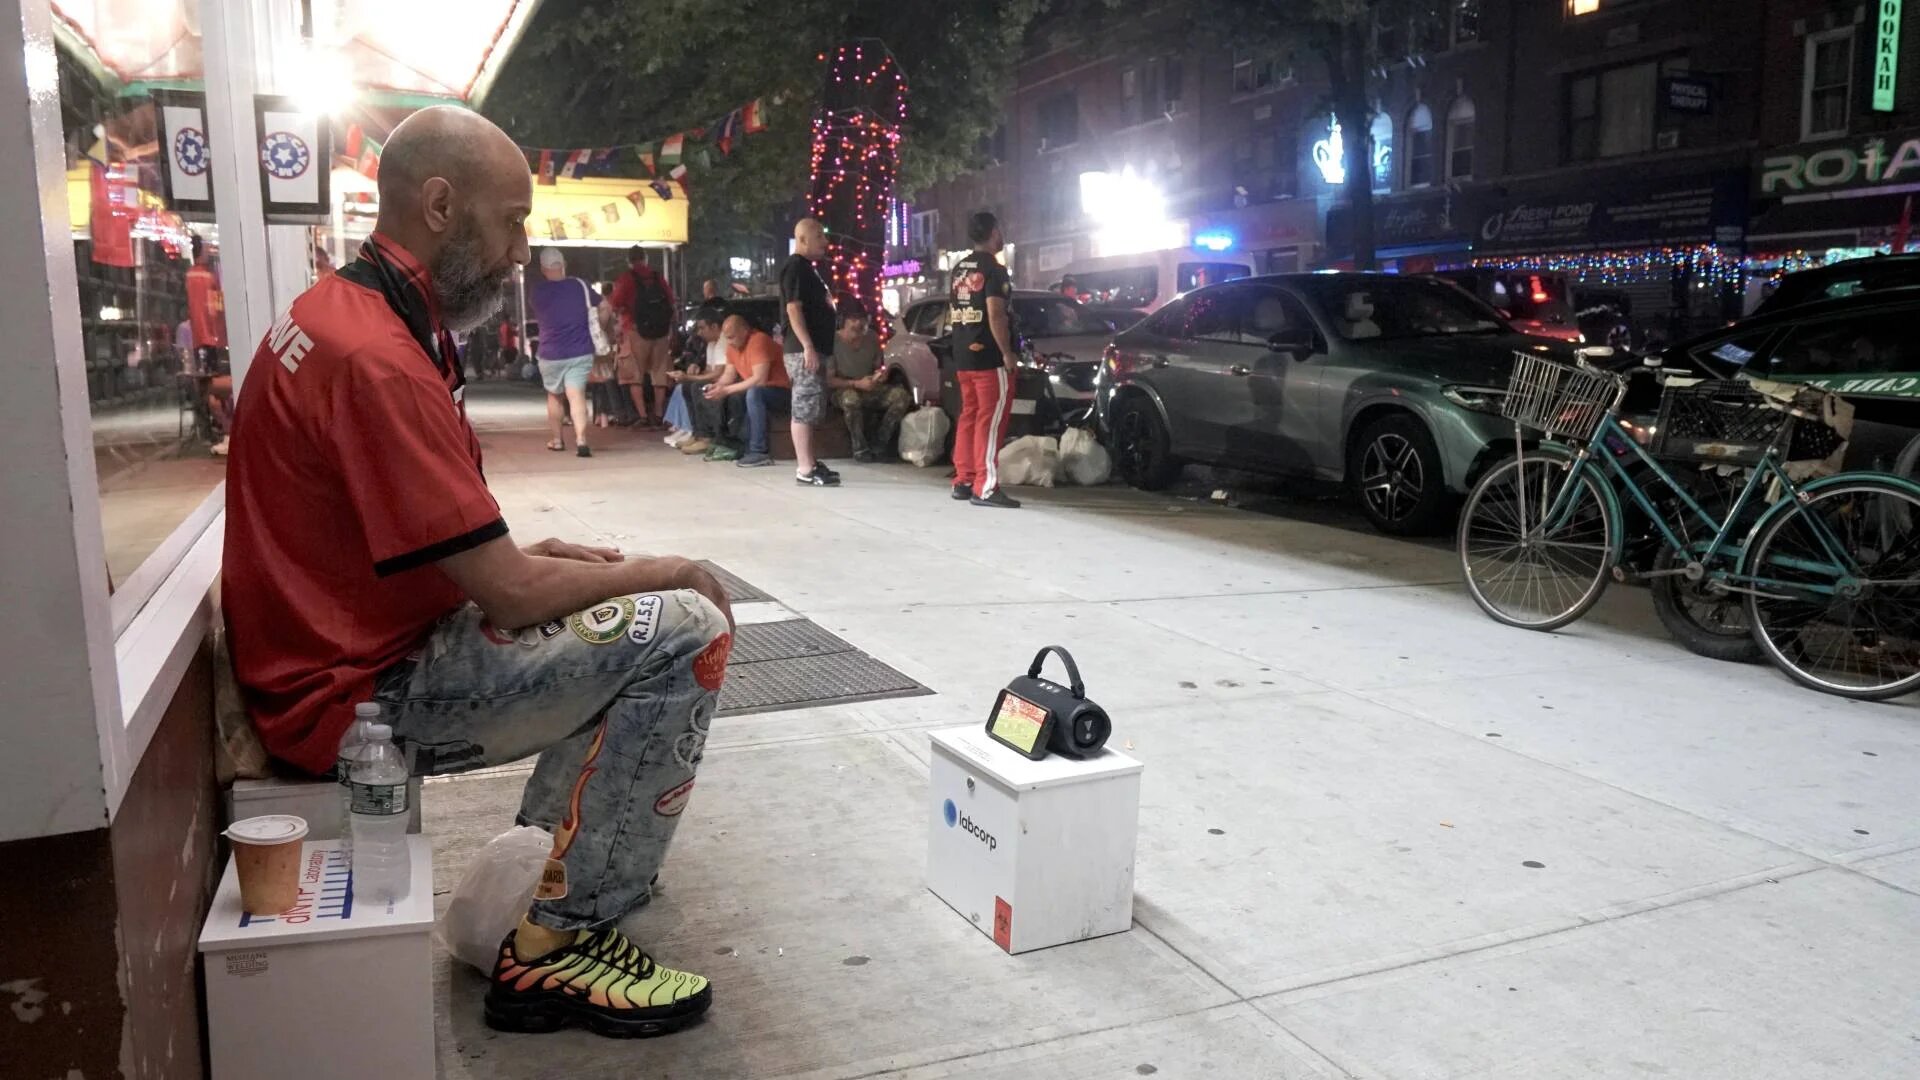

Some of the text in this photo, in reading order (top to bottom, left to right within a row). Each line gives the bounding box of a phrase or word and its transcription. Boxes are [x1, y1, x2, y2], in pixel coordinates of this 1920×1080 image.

[1555, 202, 1597, 218] POND
[959, 809, 997, 851] labcorp
[303, 850, 329, 884] Laboratory
